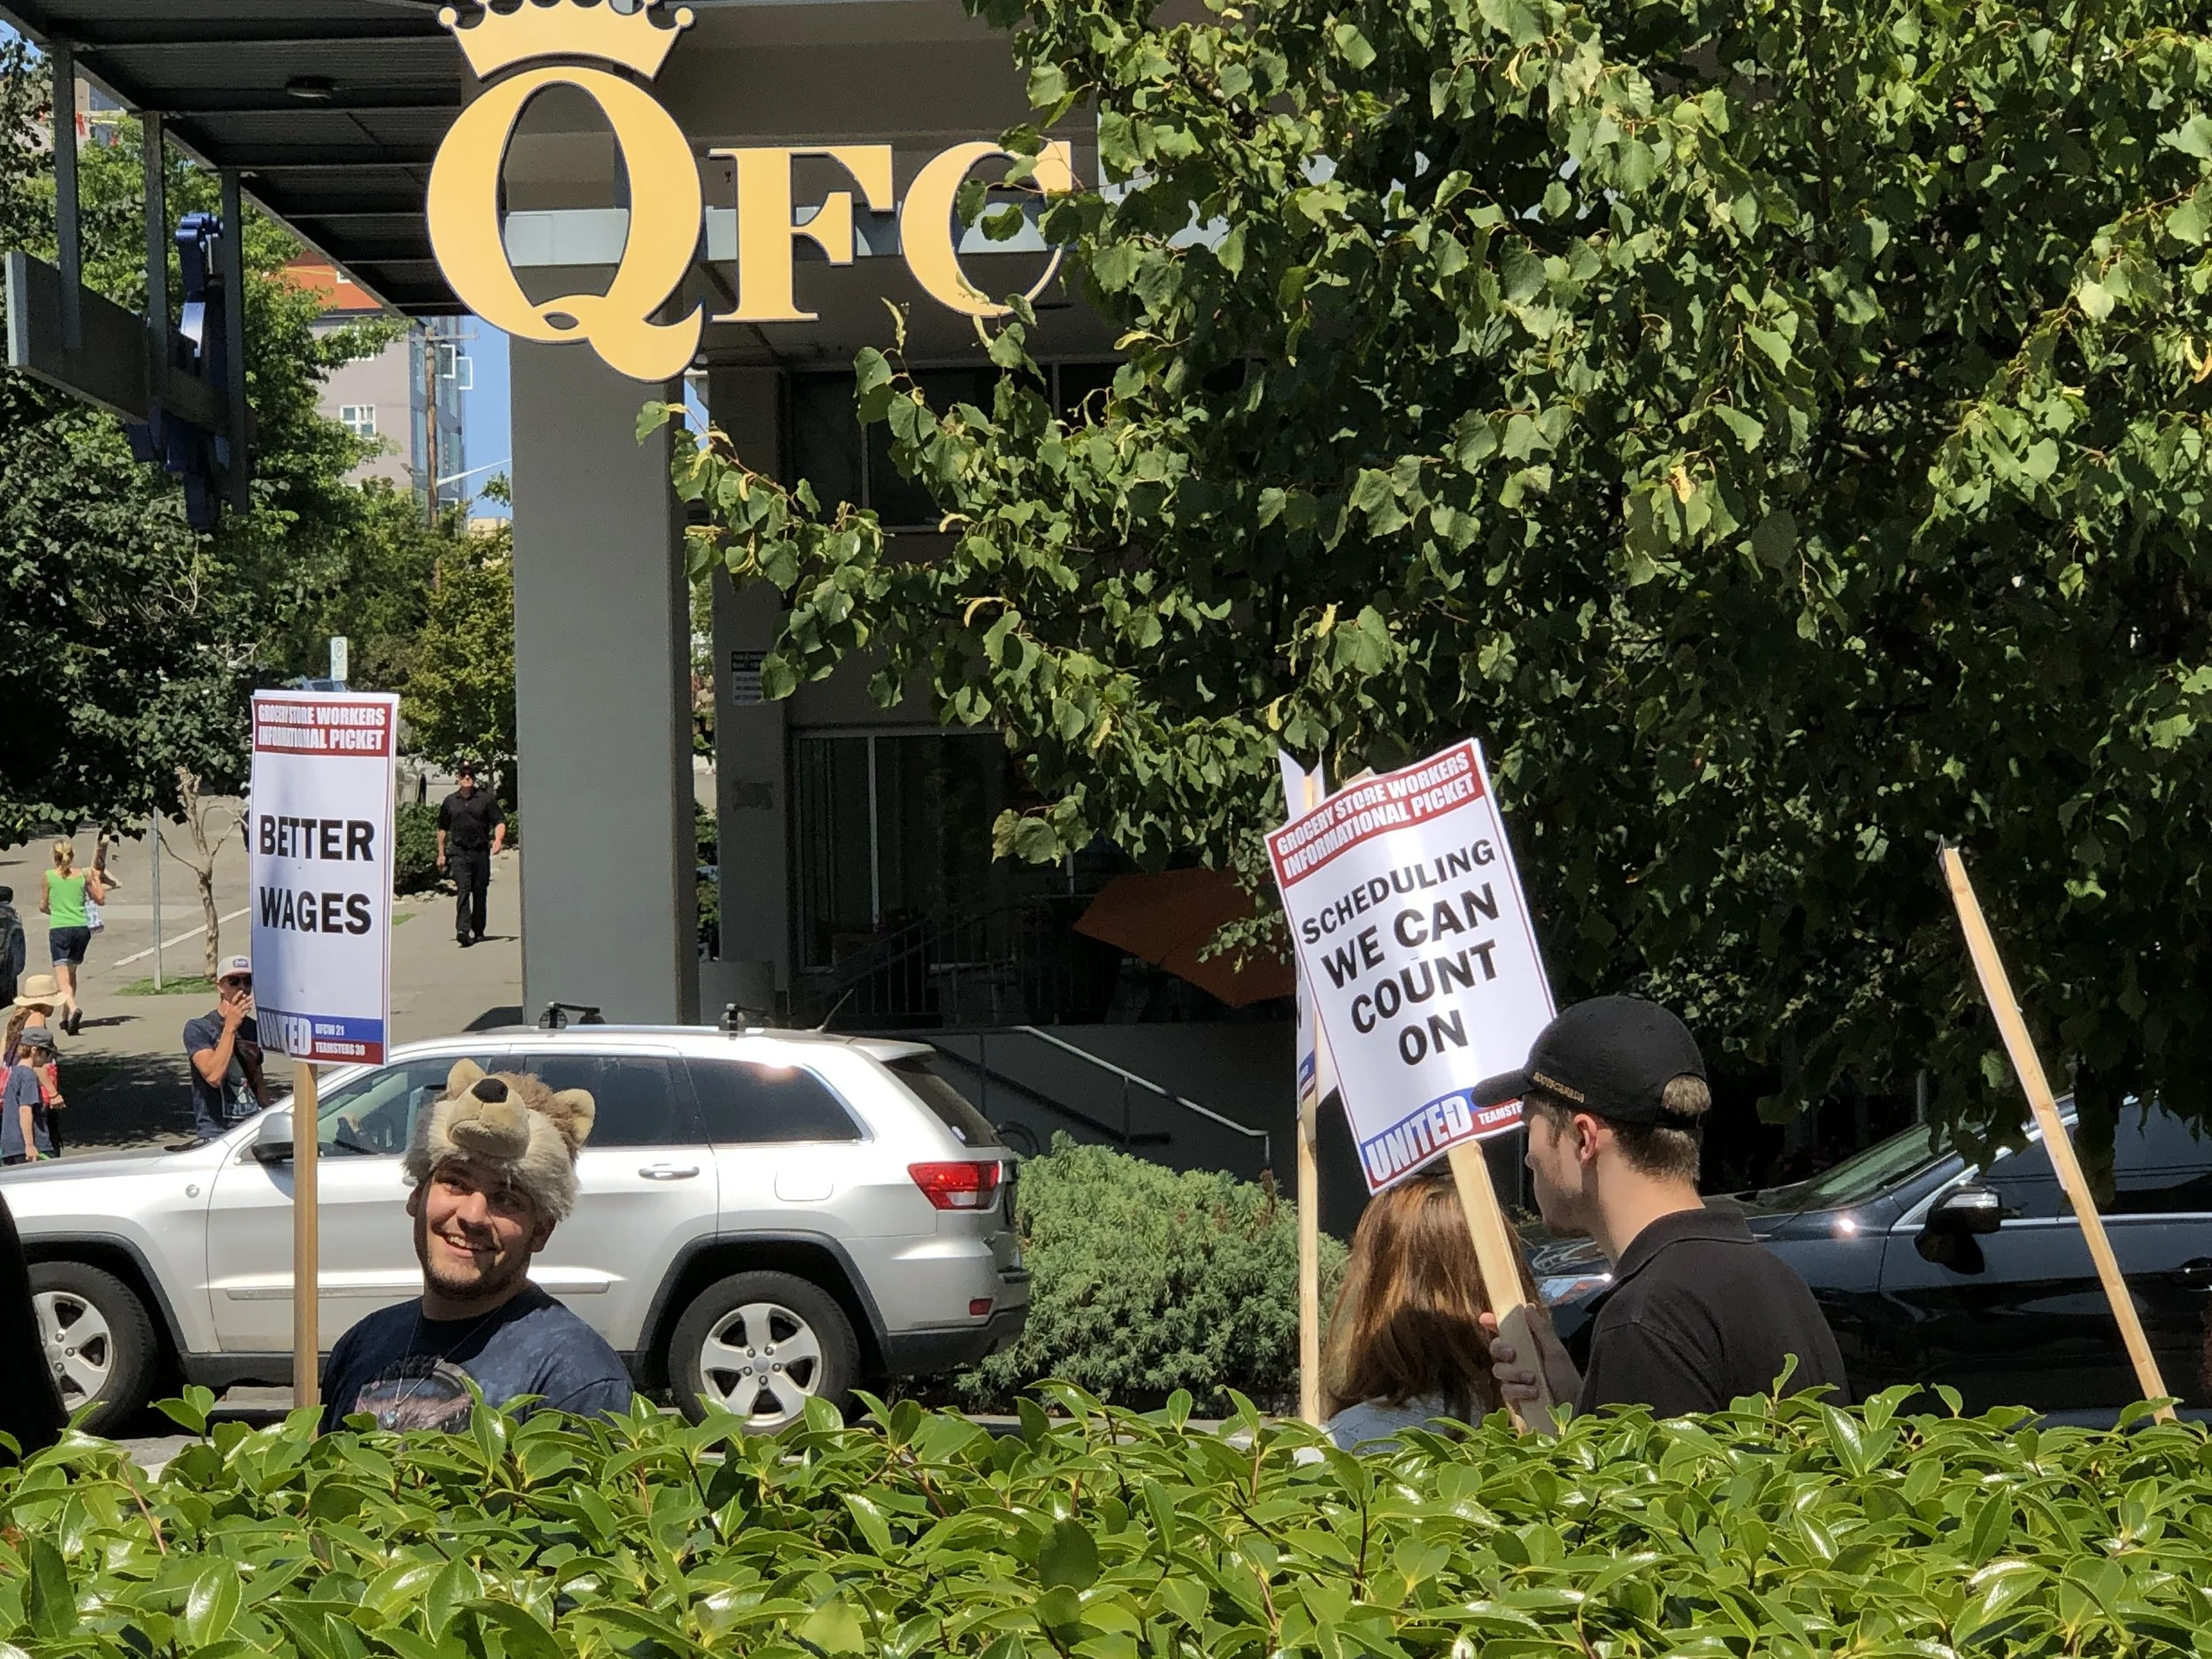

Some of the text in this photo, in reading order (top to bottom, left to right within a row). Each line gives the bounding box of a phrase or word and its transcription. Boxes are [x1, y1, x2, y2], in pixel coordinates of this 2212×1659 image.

[425, 65, 1074, 383] QFC
[317, 707, 386, 726] WORKERS
[329, 729, 385, 750] PICKET
[1276, 750, 1470, 856] GROCERY STORE WORKERS
[1282, 772, 1476, 879] INFORMATIONAL PICKET
[259, 814, 374, 862] BETTER
[259, 886, 372, 935] WAGES
[1302, 839, 1496, 944] SCHEDULING
[1320, 882, 1500, 989] WE CAN
[1351, 939, 1497, 1033] COUNT
[315, 1041, 354, 1055] TEAMSTERS
[336, 1025, 345, 1036] 21
[1399, 1009, 1469, 1065] ON
[1365, 1094, 1474, 1182] UNITED
[1478, 1100, 1523, 1125] TEAMSTE
